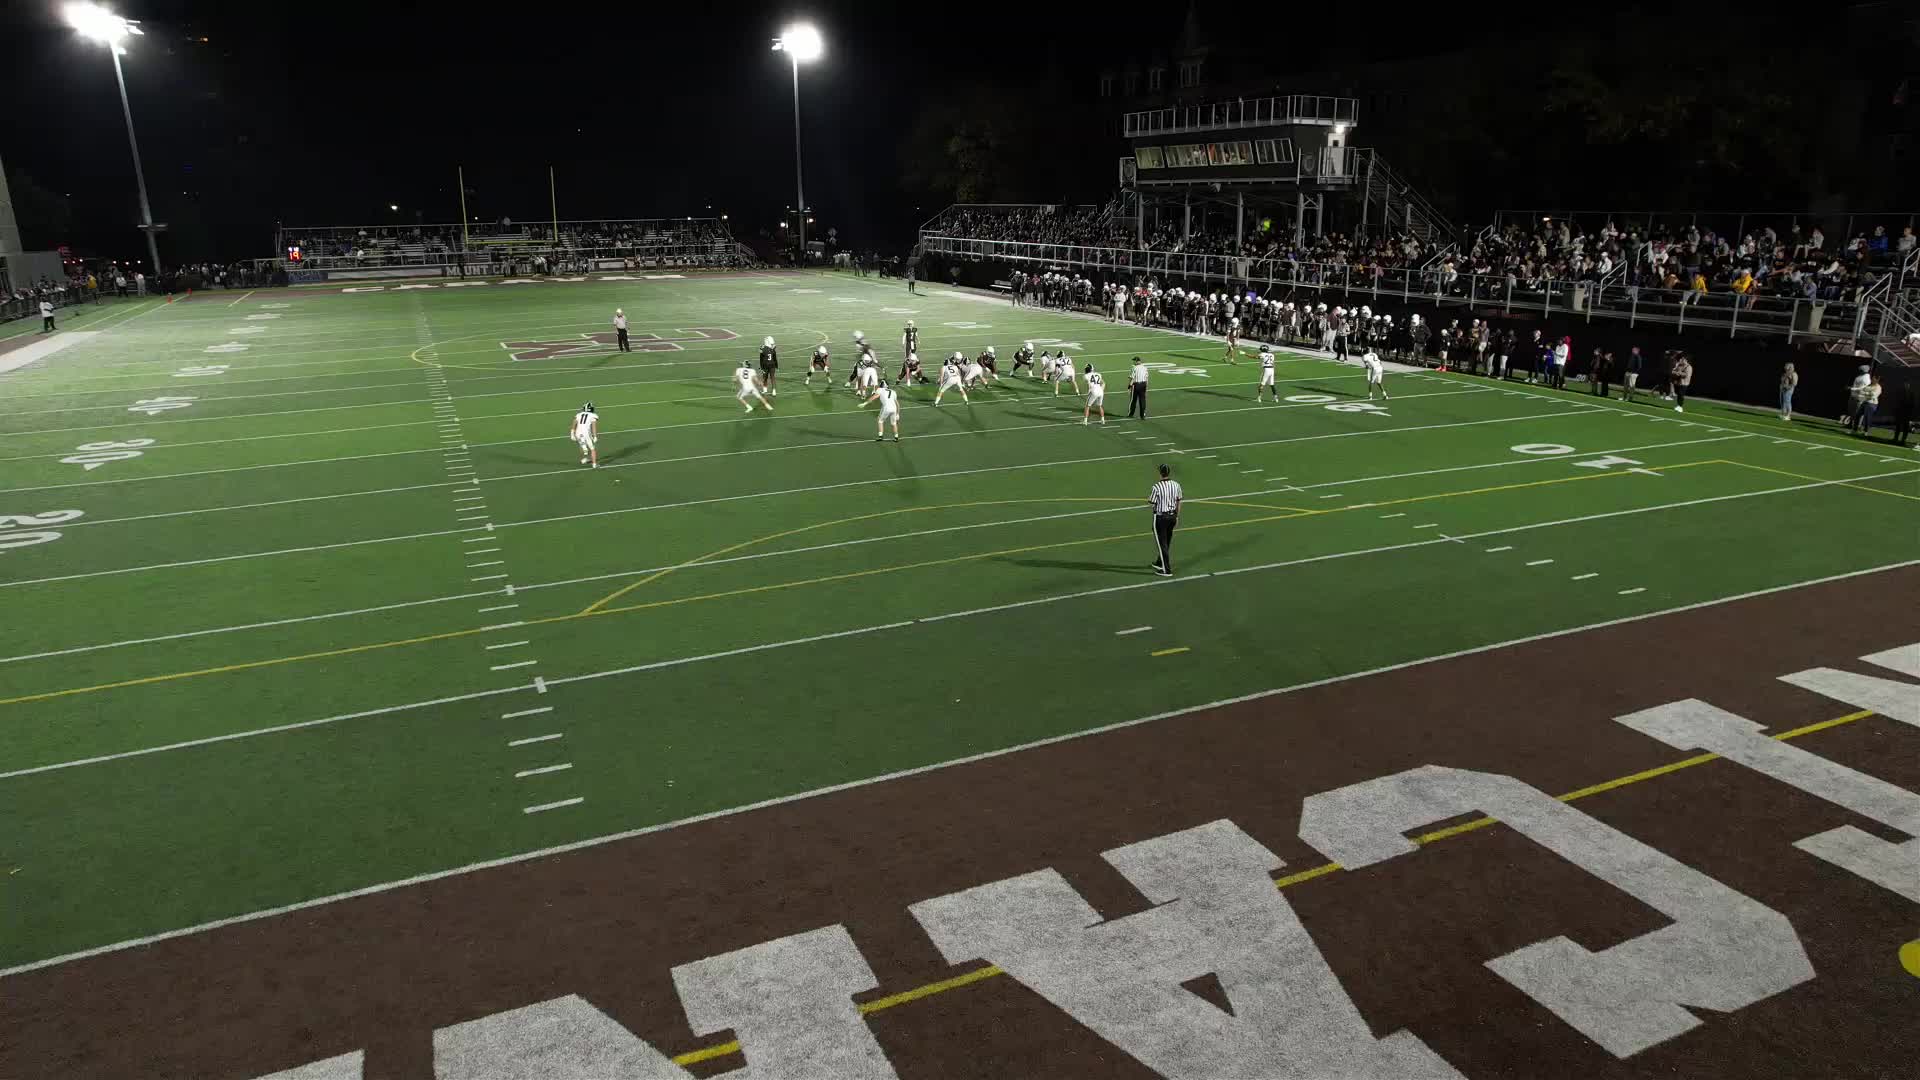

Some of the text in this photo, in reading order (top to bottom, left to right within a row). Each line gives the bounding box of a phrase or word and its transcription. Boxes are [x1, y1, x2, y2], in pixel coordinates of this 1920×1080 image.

[947, 365, 955, 374] 5
[1090, 374, 1101, 385] 42
[884, 388, 893, 399] 7
[579, 413, 589, 425] 11
[58, 438, 156, 465] 30
[1509, 443, 1645, 470] 10
